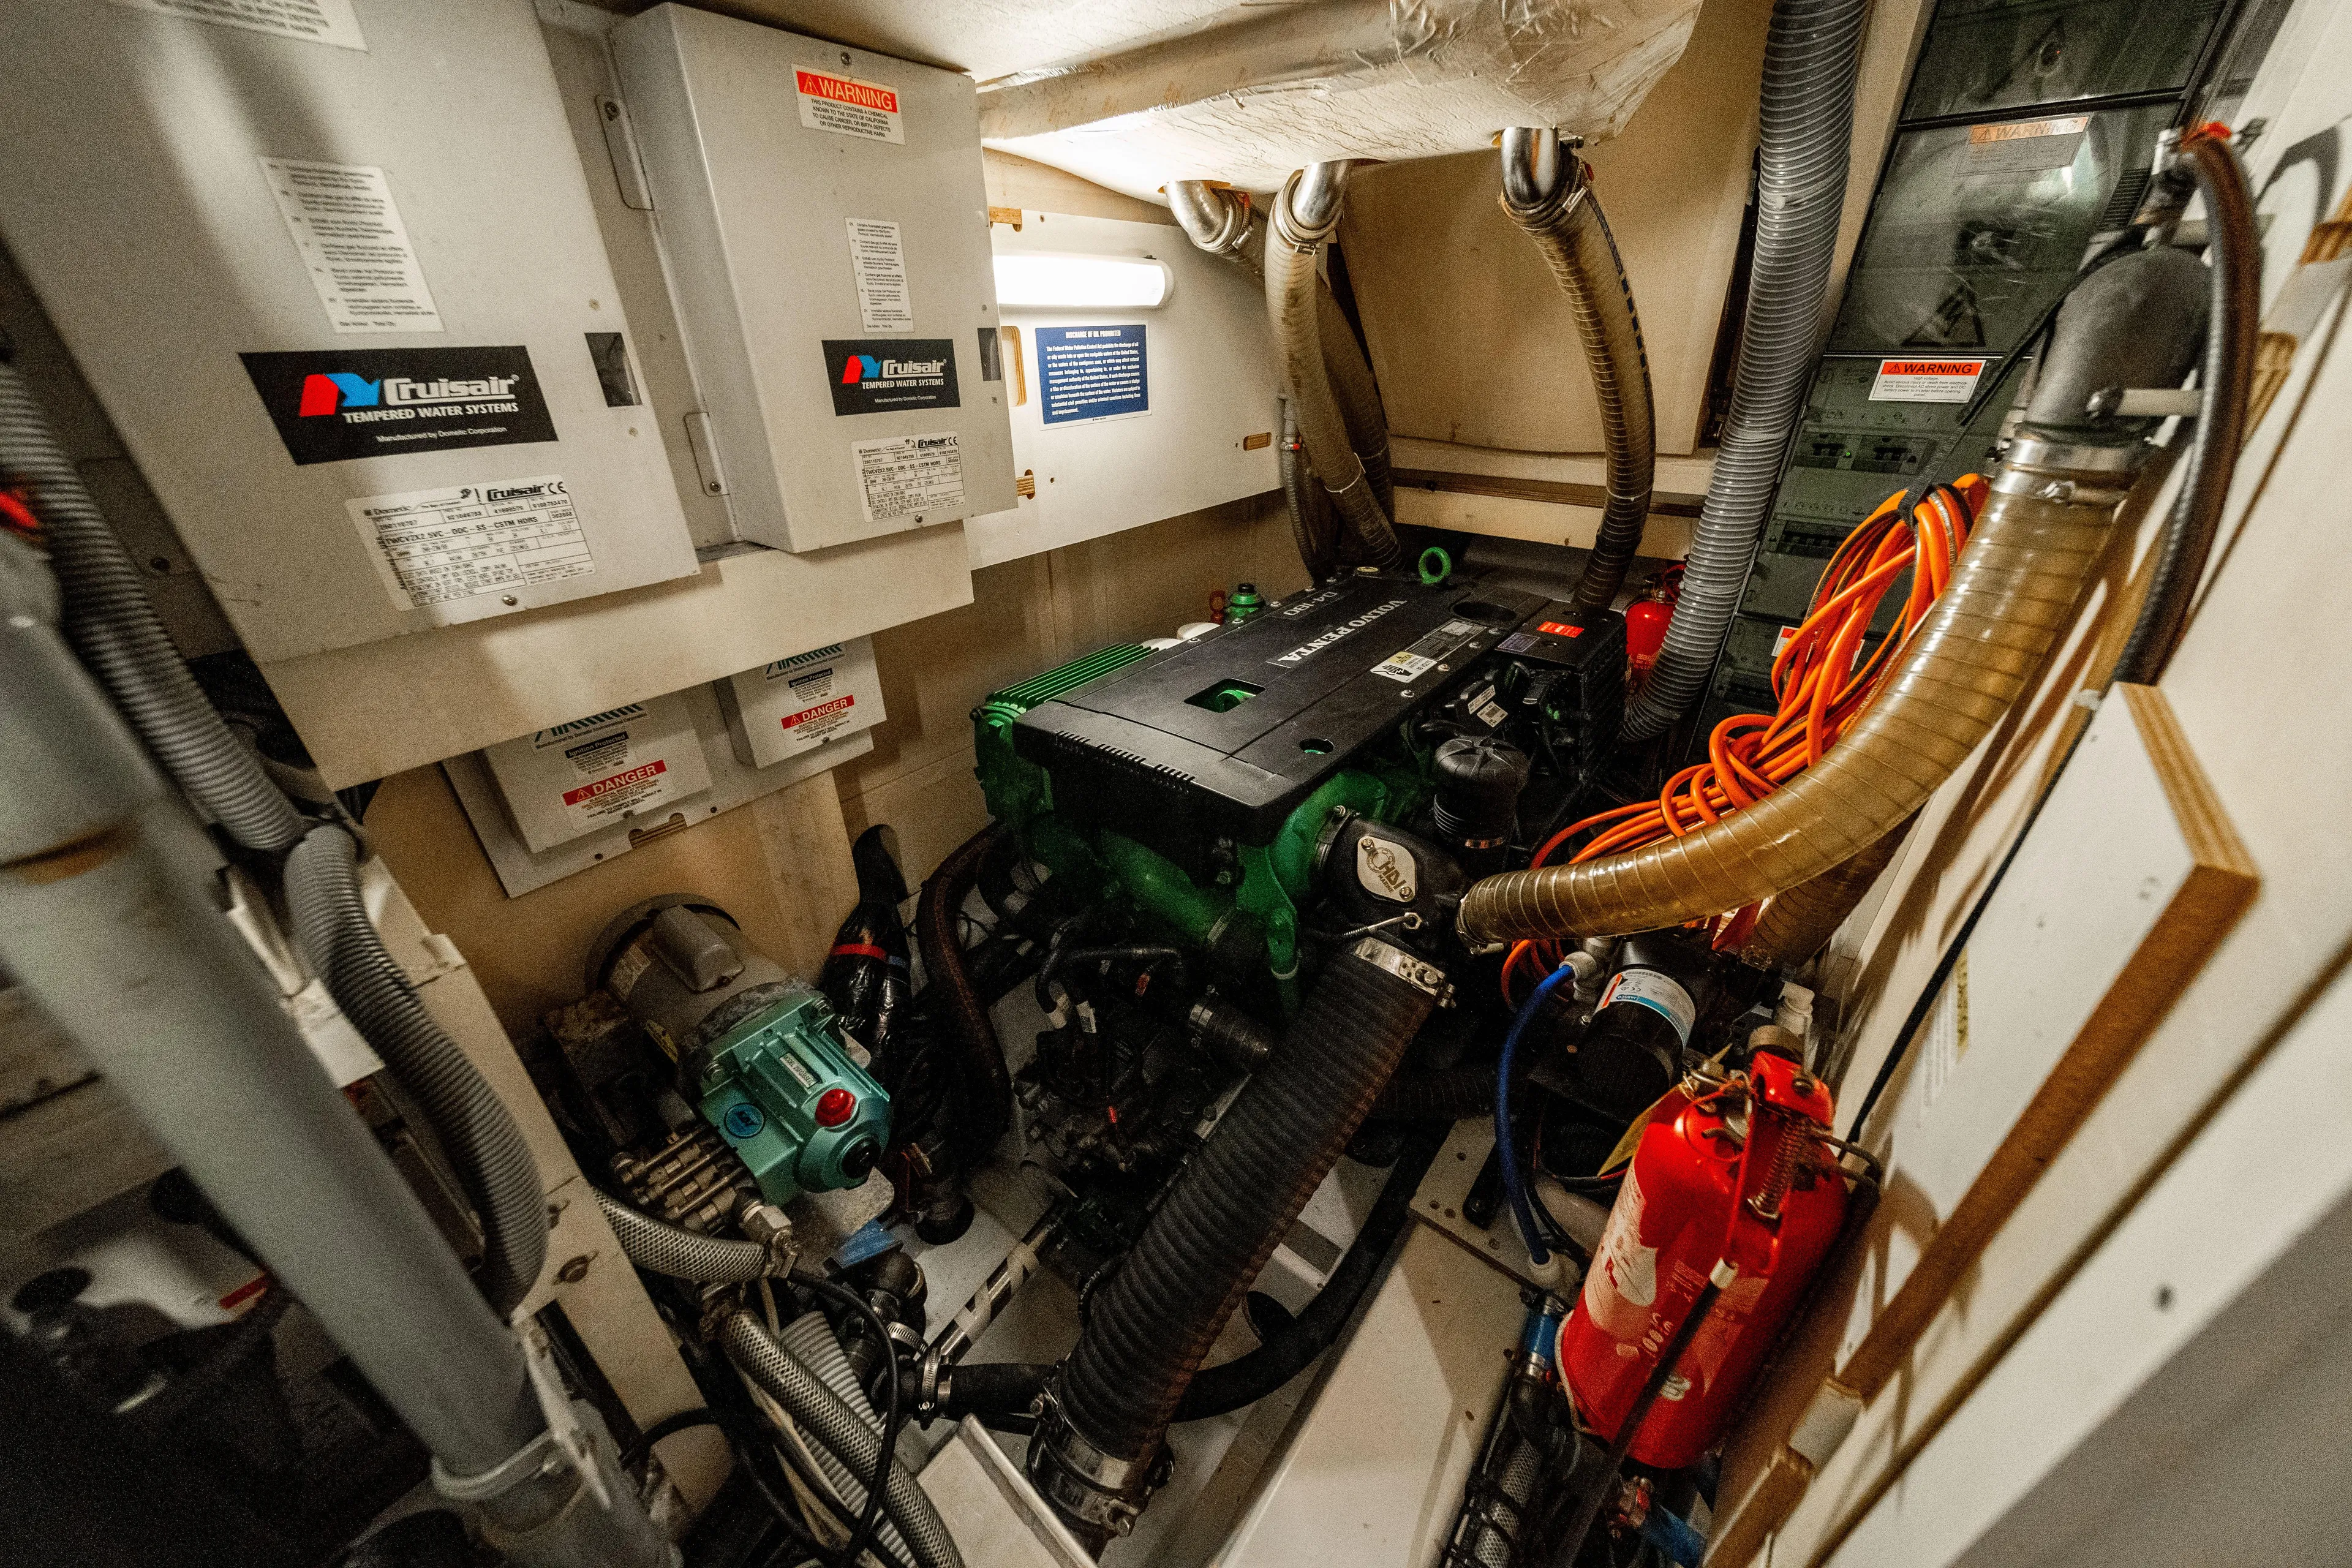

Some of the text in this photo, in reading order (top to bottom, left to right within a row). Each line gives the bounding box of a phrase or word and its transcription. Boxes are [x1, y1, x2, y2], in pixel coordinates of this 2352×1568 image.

[818, 77, 892, 110] WARNING
[812, 105, 829, 113] KNOWN
[865, 116, 888, 125] CALIFORNIA
[821, 100, 842, 109] PRODUCT
[843, 105, 863, 114] CONTAINS
[867, 110, 888, 119] CHEMICAL
[835, 116, 853, 125] CANCER,
[842, 124, 873, 135] REPRODUCTIVE
[883, 360, 944, 378] Cruisair
[1902, 364, 1973, 374] WARNING
[384, 377, 515, 405] Cruisair
[862, 380, 894, 389] TEMPERED
[343, 402, 519, 423] TEMPERED WATER SYSTEMS
[376, 432, 426, 442] Manufactured
[468, 427, 507, 435] Corporation
[918, 437, 946, 448] Cruisair
[488, 484, 545, 502] Cruisair
[1283, 591, 1338, 616] D4-180
[1277, 600, 1408, 662] VOLVO PENTA
[791, 671, 831, 686] Ignition Protected
[802, 699, 848, 721] DANGER
[569, 734, 625, 756] Ignition Protected
[592, 765, 657, 794] DANGER
[1378, 873, 1394, 893] MARINE
